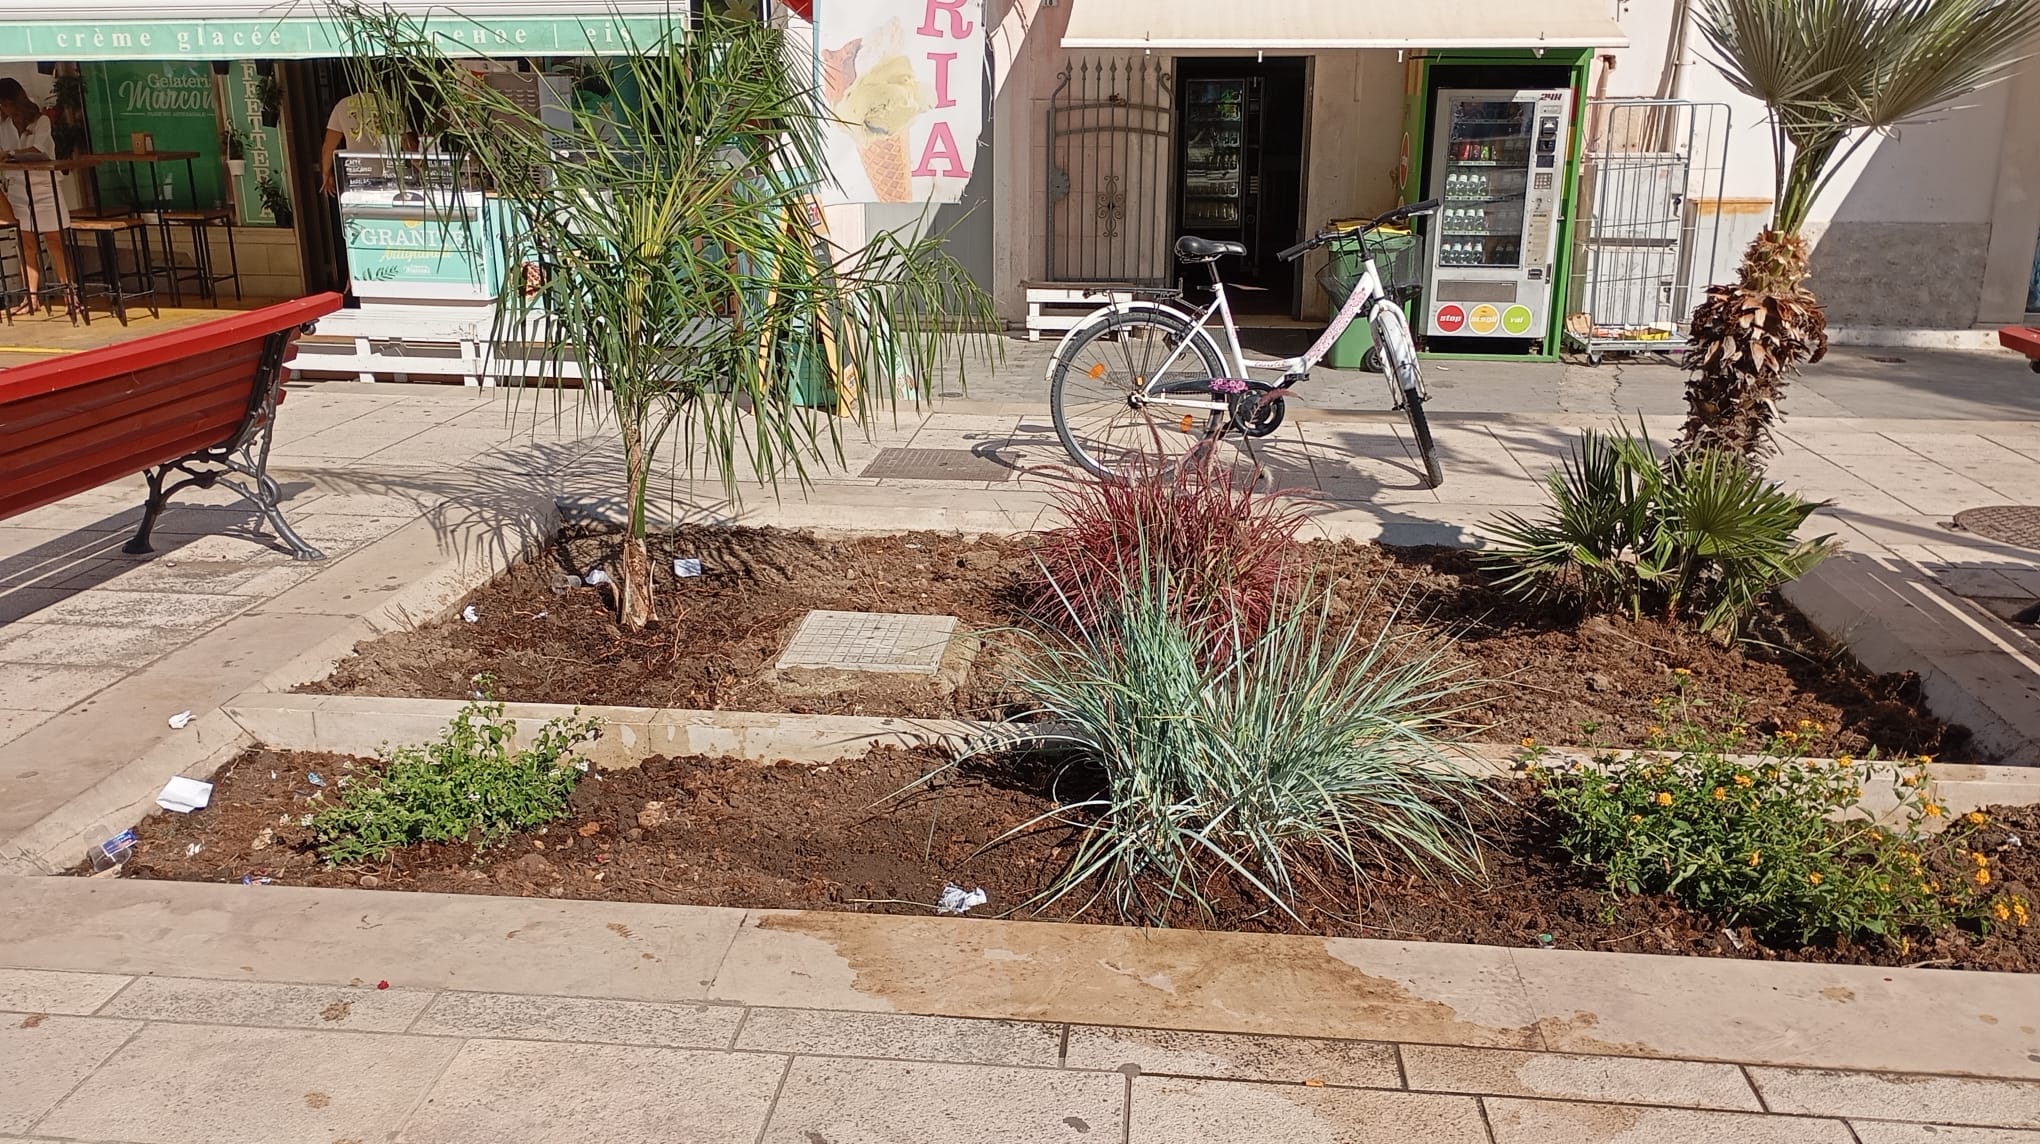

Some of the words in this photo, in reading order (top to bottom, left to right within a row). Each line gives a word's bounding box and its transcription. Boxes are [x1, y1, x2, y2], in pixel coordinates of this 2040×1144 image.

[56, 28, 152, 47] crème
[177, 21, 281, 50] glacée
[585, 22, 631, 43] eis
[147, 73, 211, 88] Gelateri
[911, 0, 974, 179] RIA
[1439, 314, 1463, 323] stop
